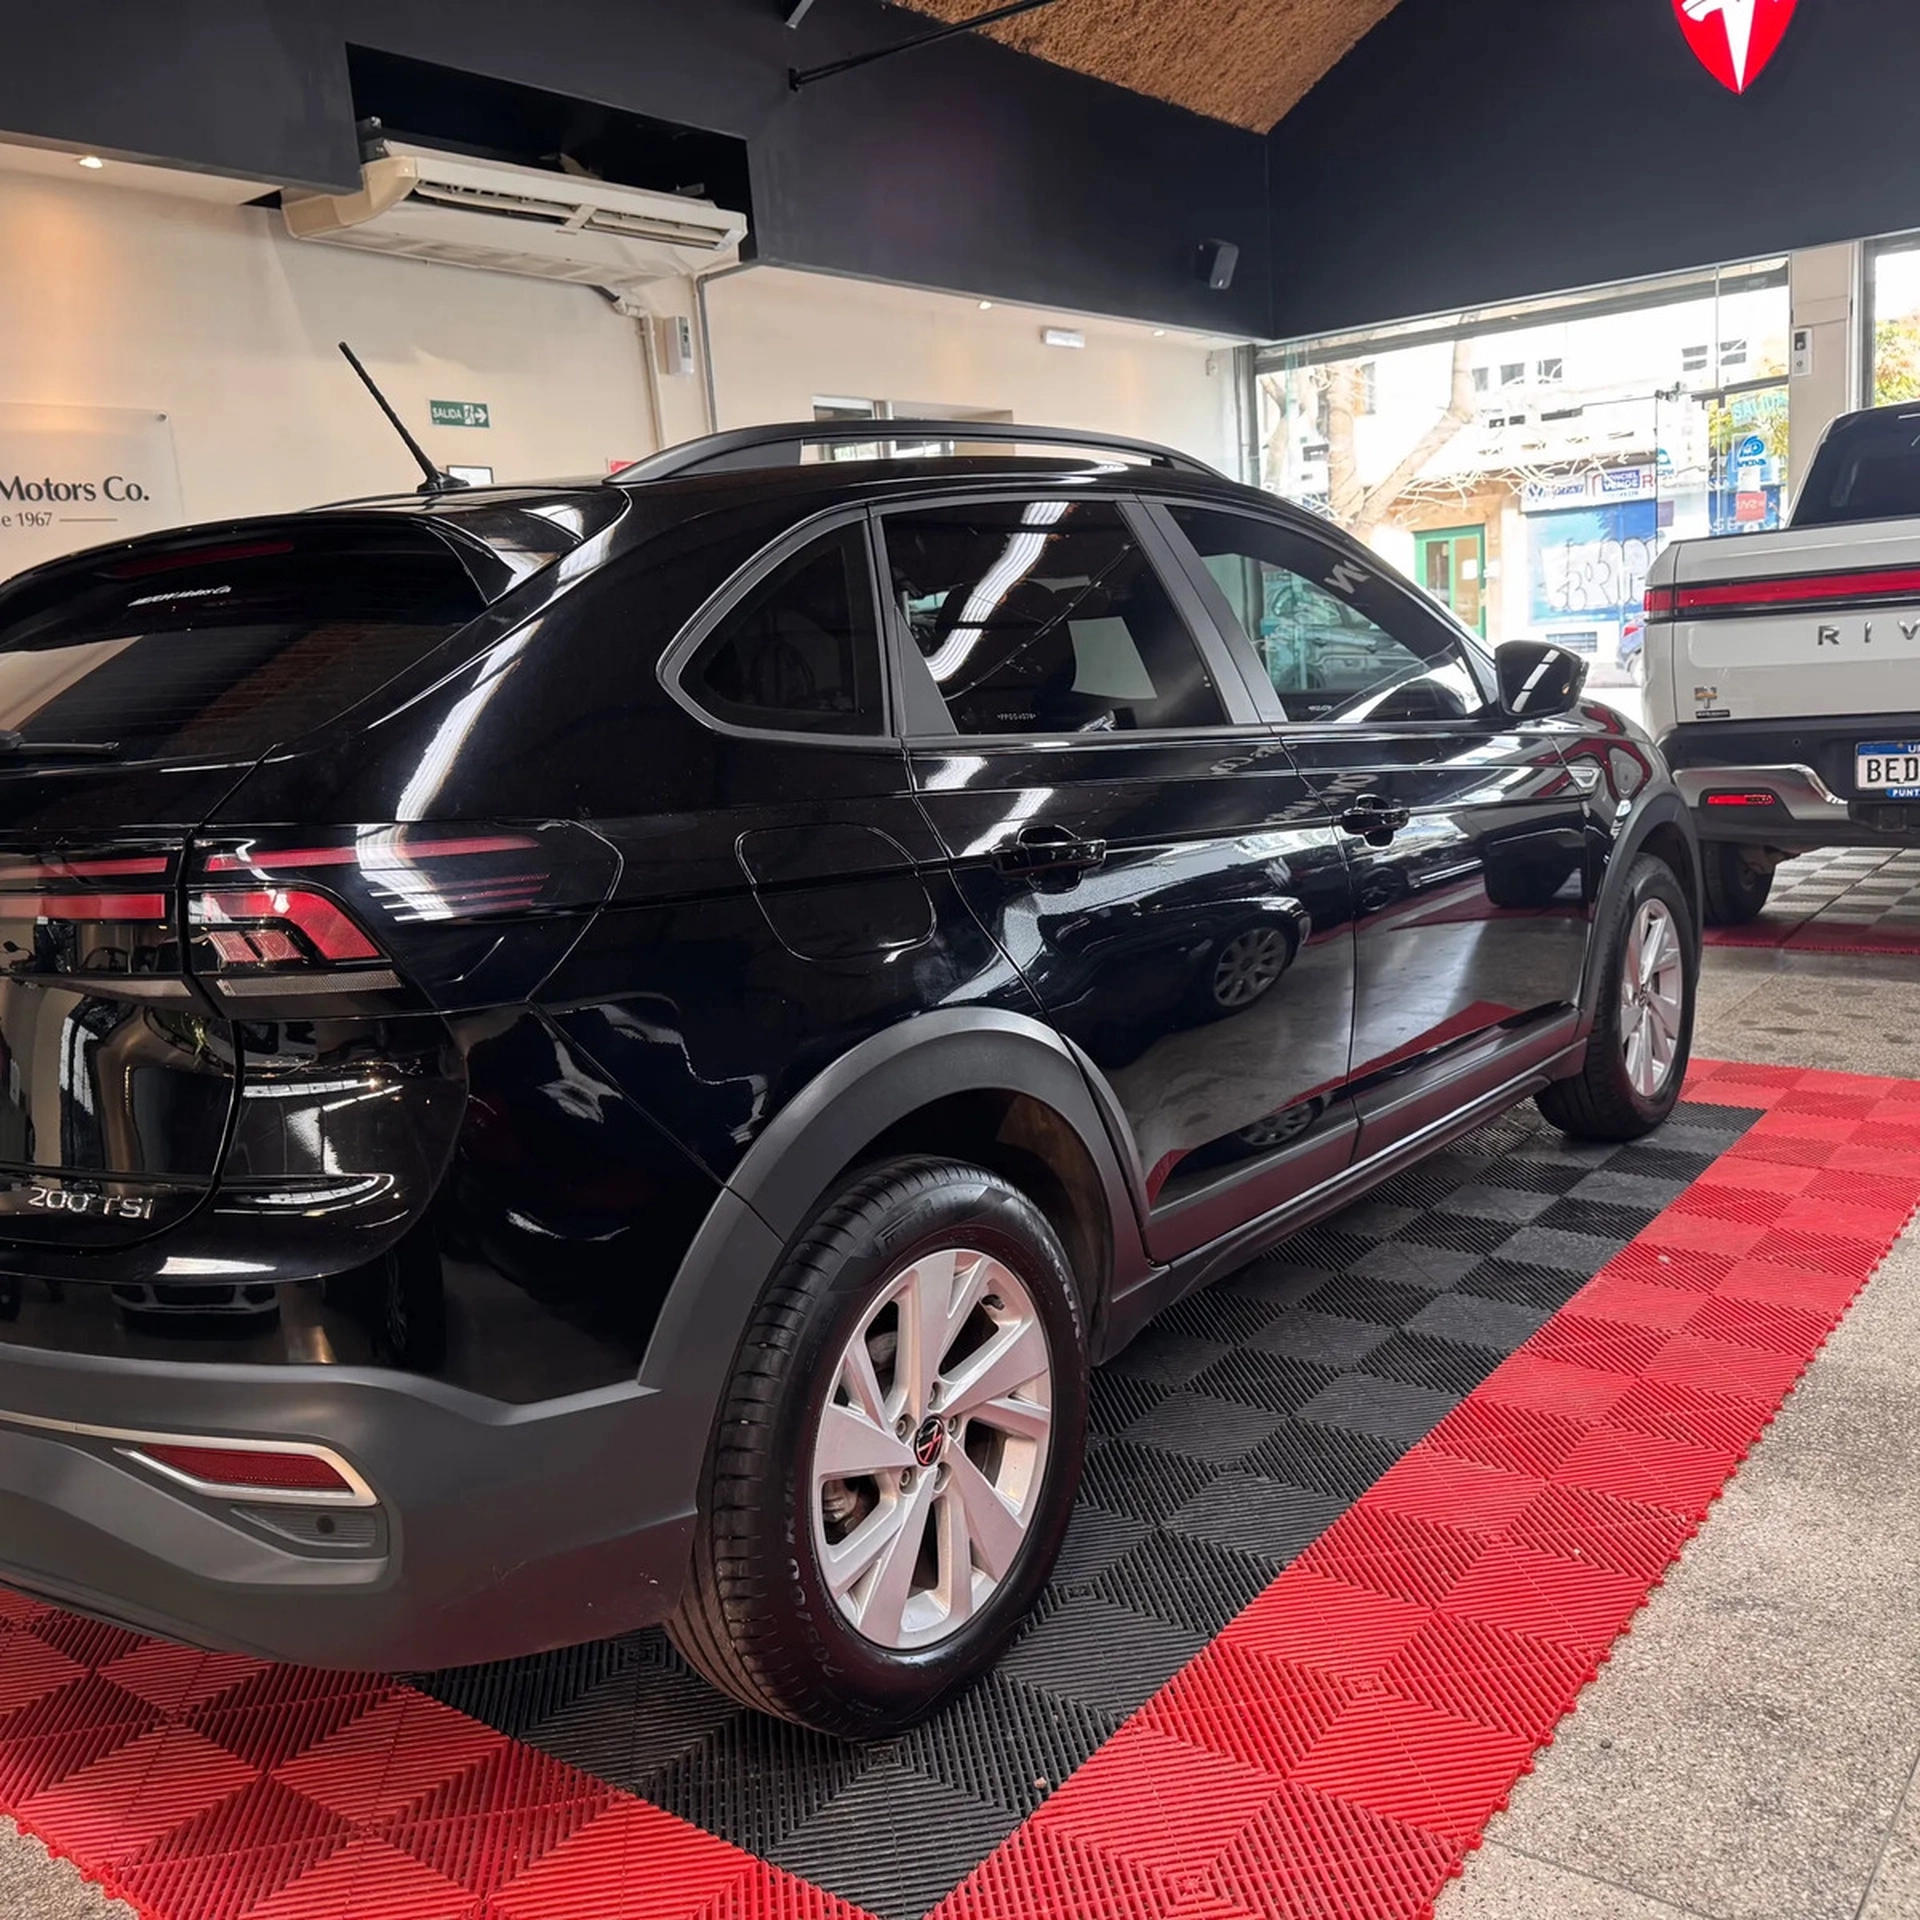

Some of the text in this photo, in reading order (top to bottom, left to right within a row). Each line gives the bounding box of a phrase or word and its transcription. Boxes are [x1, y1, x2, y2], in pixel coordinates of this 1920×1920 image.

[432, 407, 463, 420] SALIDA
[0, 475, 150, 502] Motors Co.
[18, 512, 53, 527] 1967
[1817, 619, 1920, 646] RIV
[1867, 757, 1919, 783] BED
[28, 1187, 153, 1219] 200 TSI
